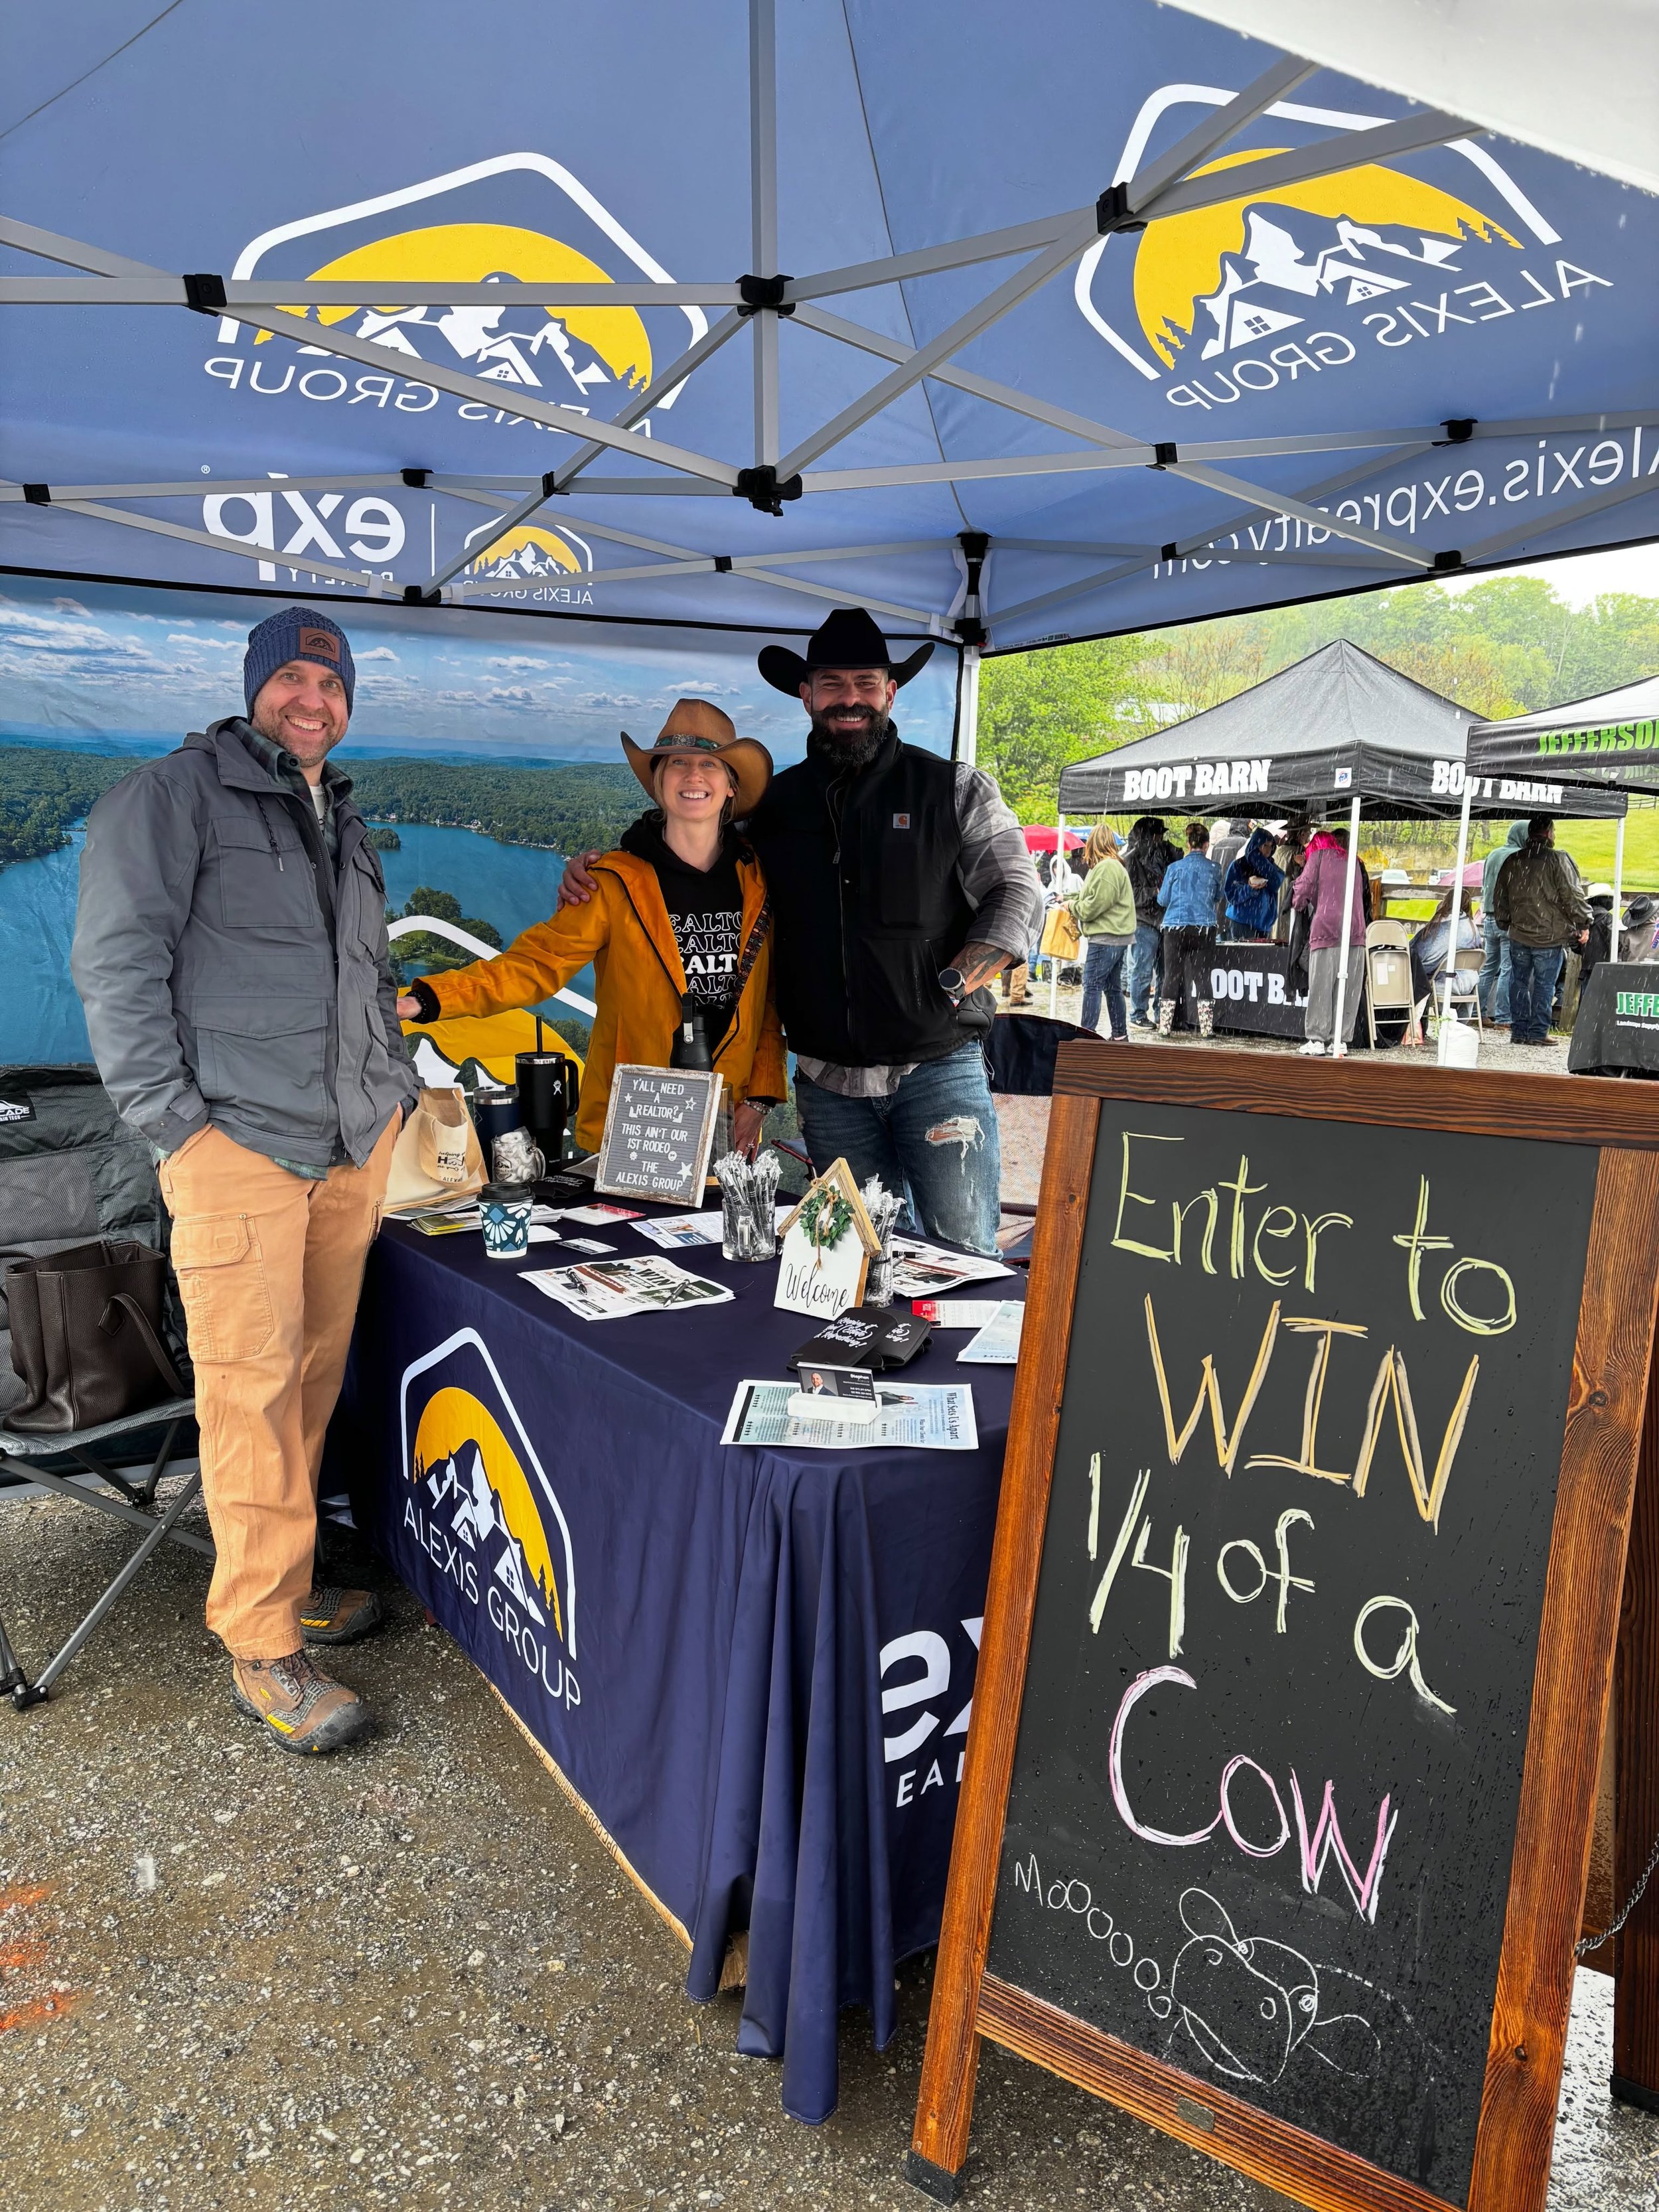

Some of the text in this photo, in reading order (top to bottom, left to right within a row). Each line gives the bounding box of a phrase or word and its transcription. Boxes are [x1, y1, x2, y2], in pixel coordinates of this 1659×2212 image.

[1536, 719, 1659, 756] JEFFERSO
[1123, 759, 1272, 801] BOOT BARN
[681, 954, 739, 974] ALT
[1191, 968, 1263, 1002] OOT
[632, 1078, 684, 1095] Y'ALL NEED
[654, 1092, 660, 1104] A
[636, 1104, 679, 1120] REALTOR?
[622, 1123, 688, 1142] THIS AIN'T OUR
[627, 1138, 670, 1153] 1ST RODEO
[642, 1161, 659, 1174] THE
[616, 1172, 683, 1191] ALEXIS GROUP
[1110, 1131, 1517, 1335] Enter to
[635, 1268, 676, 1286] WIN
[786, 1260, 849, 1317] Welcome
[946, 1392, 957, 1404] What
[948, 1405, 958, 1416] Sets
[1144, 1292, 1479, 1536] WIN
[946, 1424, 960, 1439] Apart
[1088, 1452, 1457, 1714] 1/4 of a
[403, 1497, 581, 1711] ALEXIS GROUP
